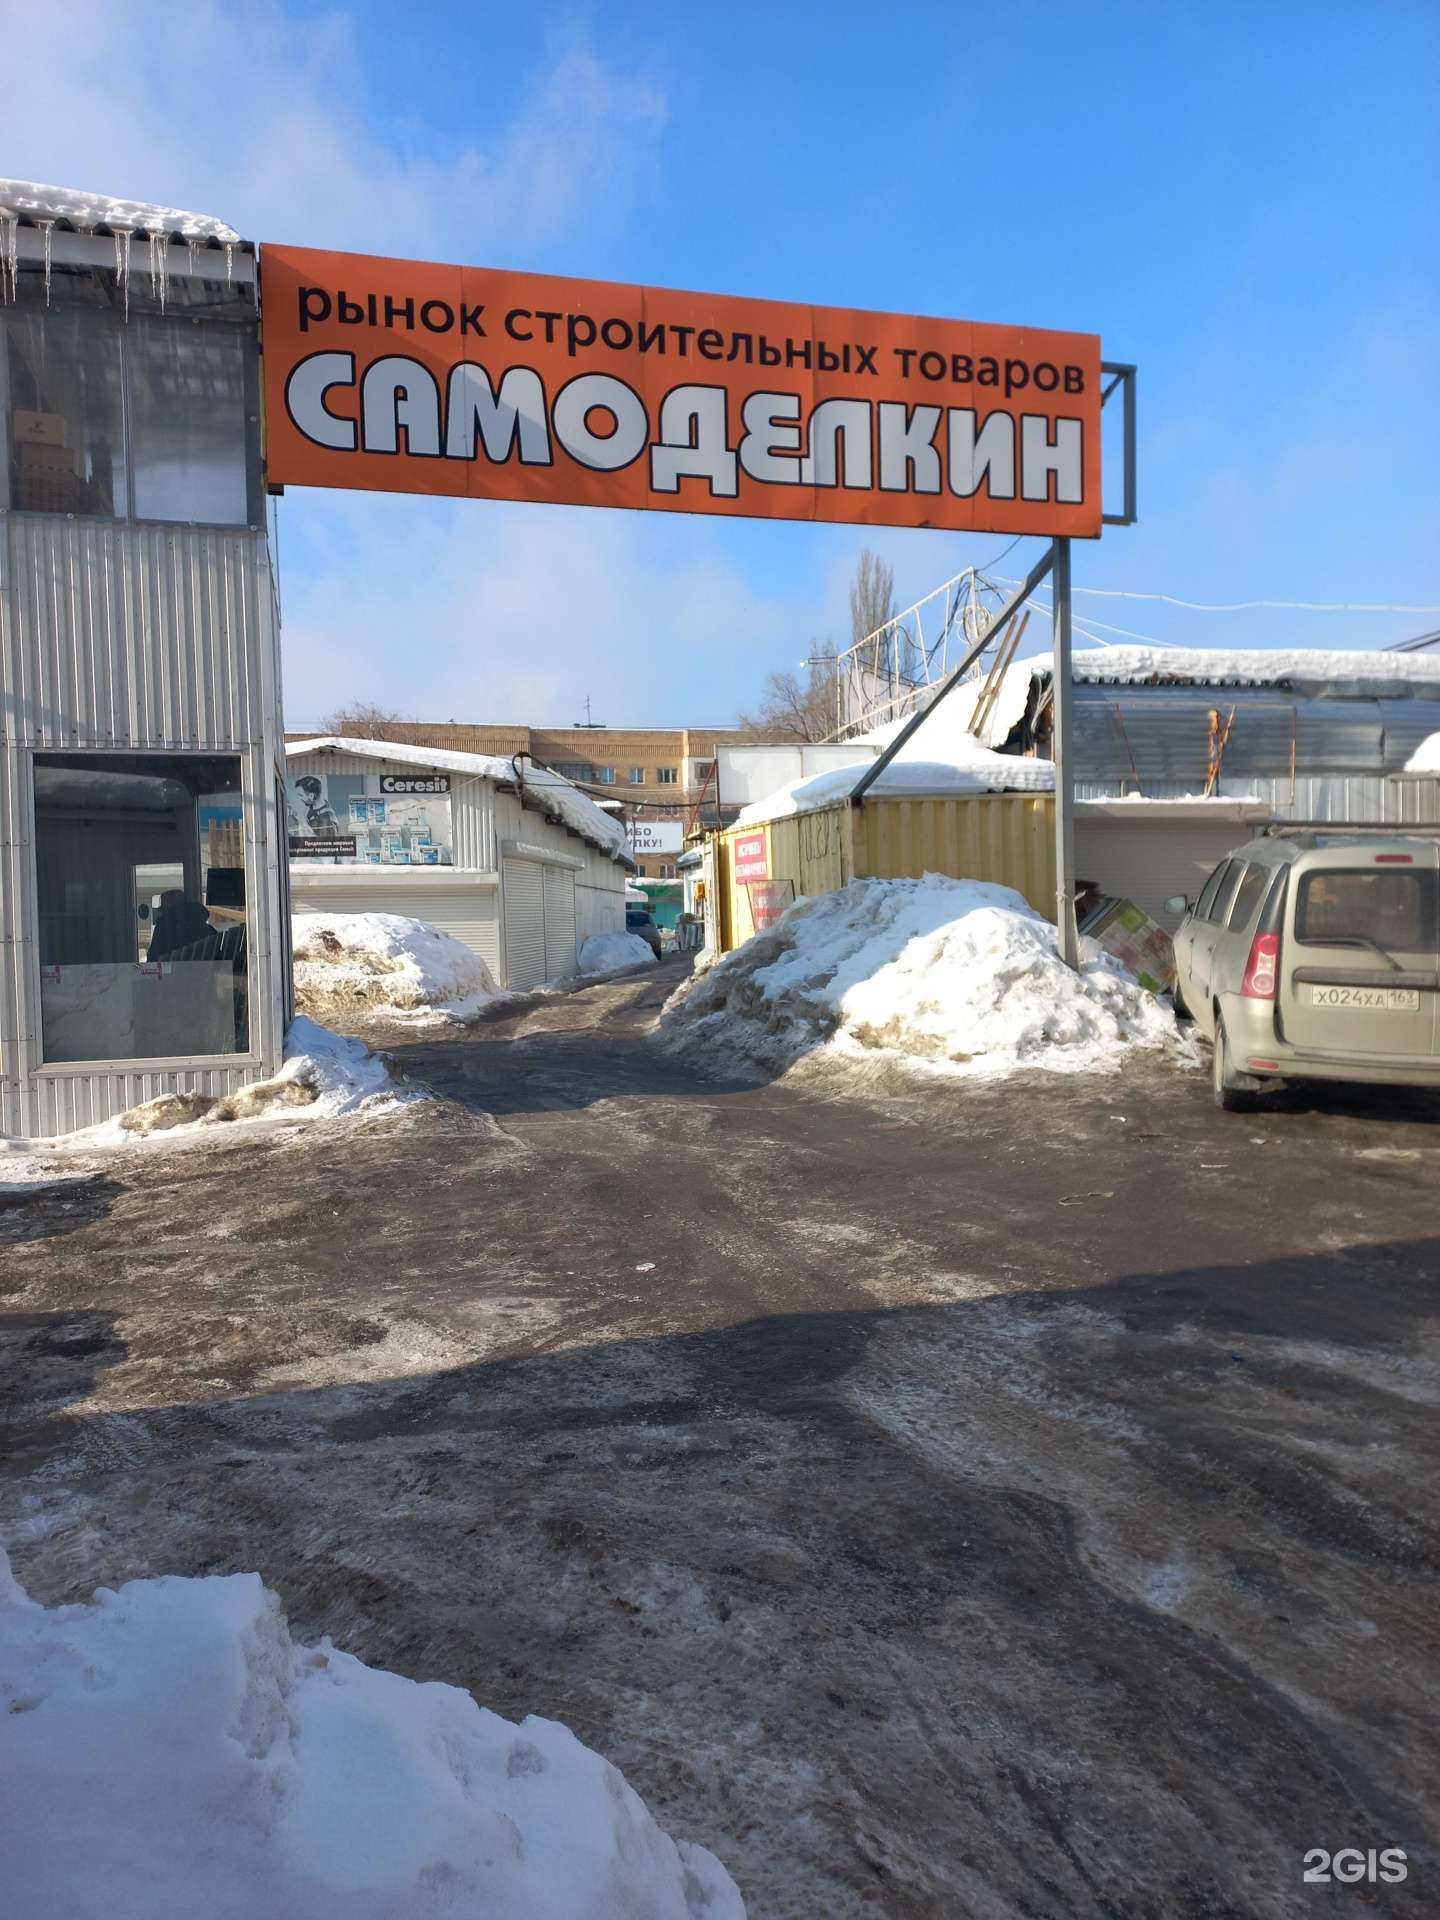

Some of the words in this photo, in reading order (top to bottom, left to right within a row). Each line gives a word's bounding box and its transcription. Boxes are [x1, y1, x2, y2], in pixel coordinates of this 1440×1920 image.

[298, 286, 487, 337] рынок
[504, 308, 879, 376] строительных
[893, 348, 1085, 399] товаров
[284, 349, 1084, 504] САМОДЕЛКИН
[383, 776, 448, 792] Ceresit
